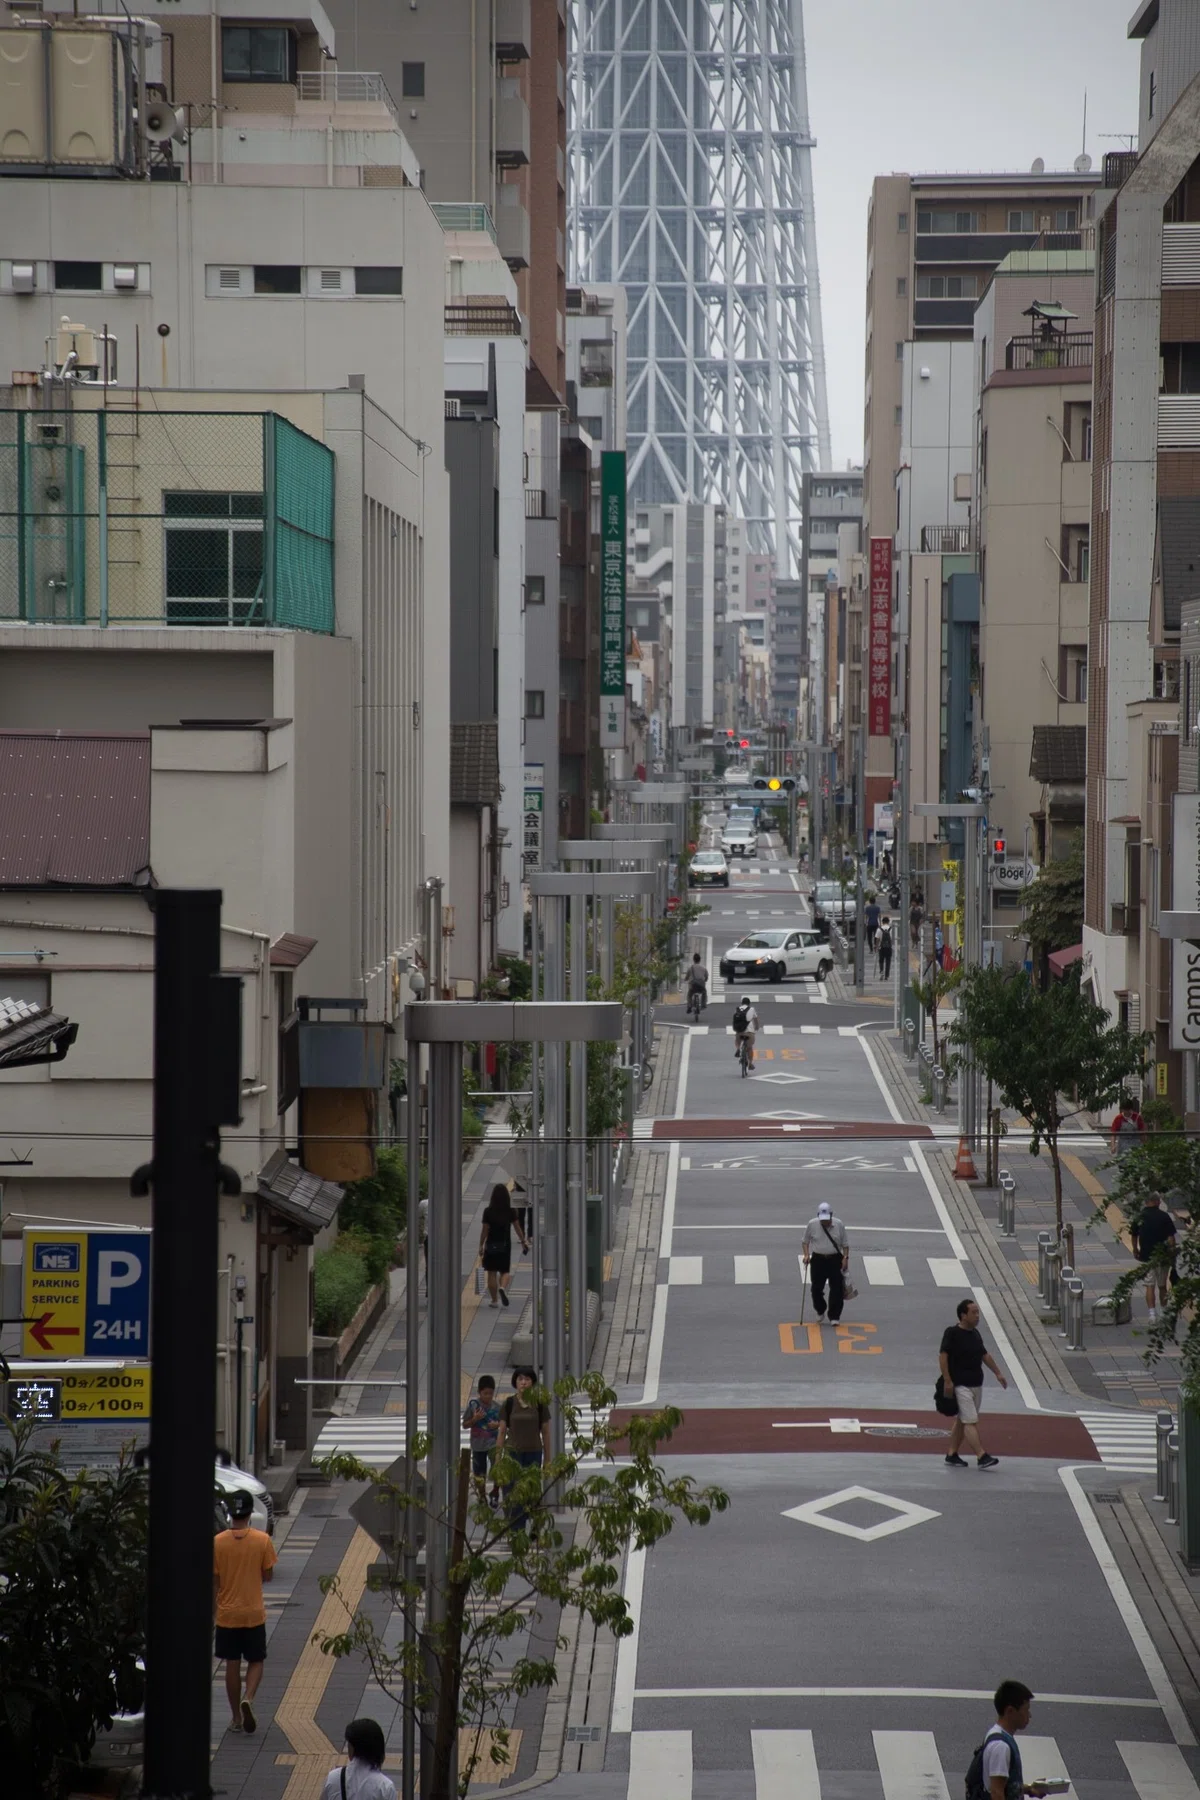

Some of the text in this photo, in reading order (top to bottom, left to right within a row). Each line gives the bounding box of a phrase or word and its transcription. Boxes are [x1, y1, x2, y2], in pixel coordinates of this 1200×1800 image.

[604, 540, 623, 687] 東京法律専門学校
[524, 793, 540, 866] 貸会議室
[42, 1255, 70, 1268] NS
[32, 1279, 80, 1288] PARKING
[97, 1250, 142, 1305] P
[32, 1295, 80, 1304] SERVICE
[92, 1319, 141, 1340] 24H
[778, 1322, 883, 1354] 30
[61, 1376, 144, 1389] 0分/200円
[60, 1399, 144, 1411] 0分/100円
